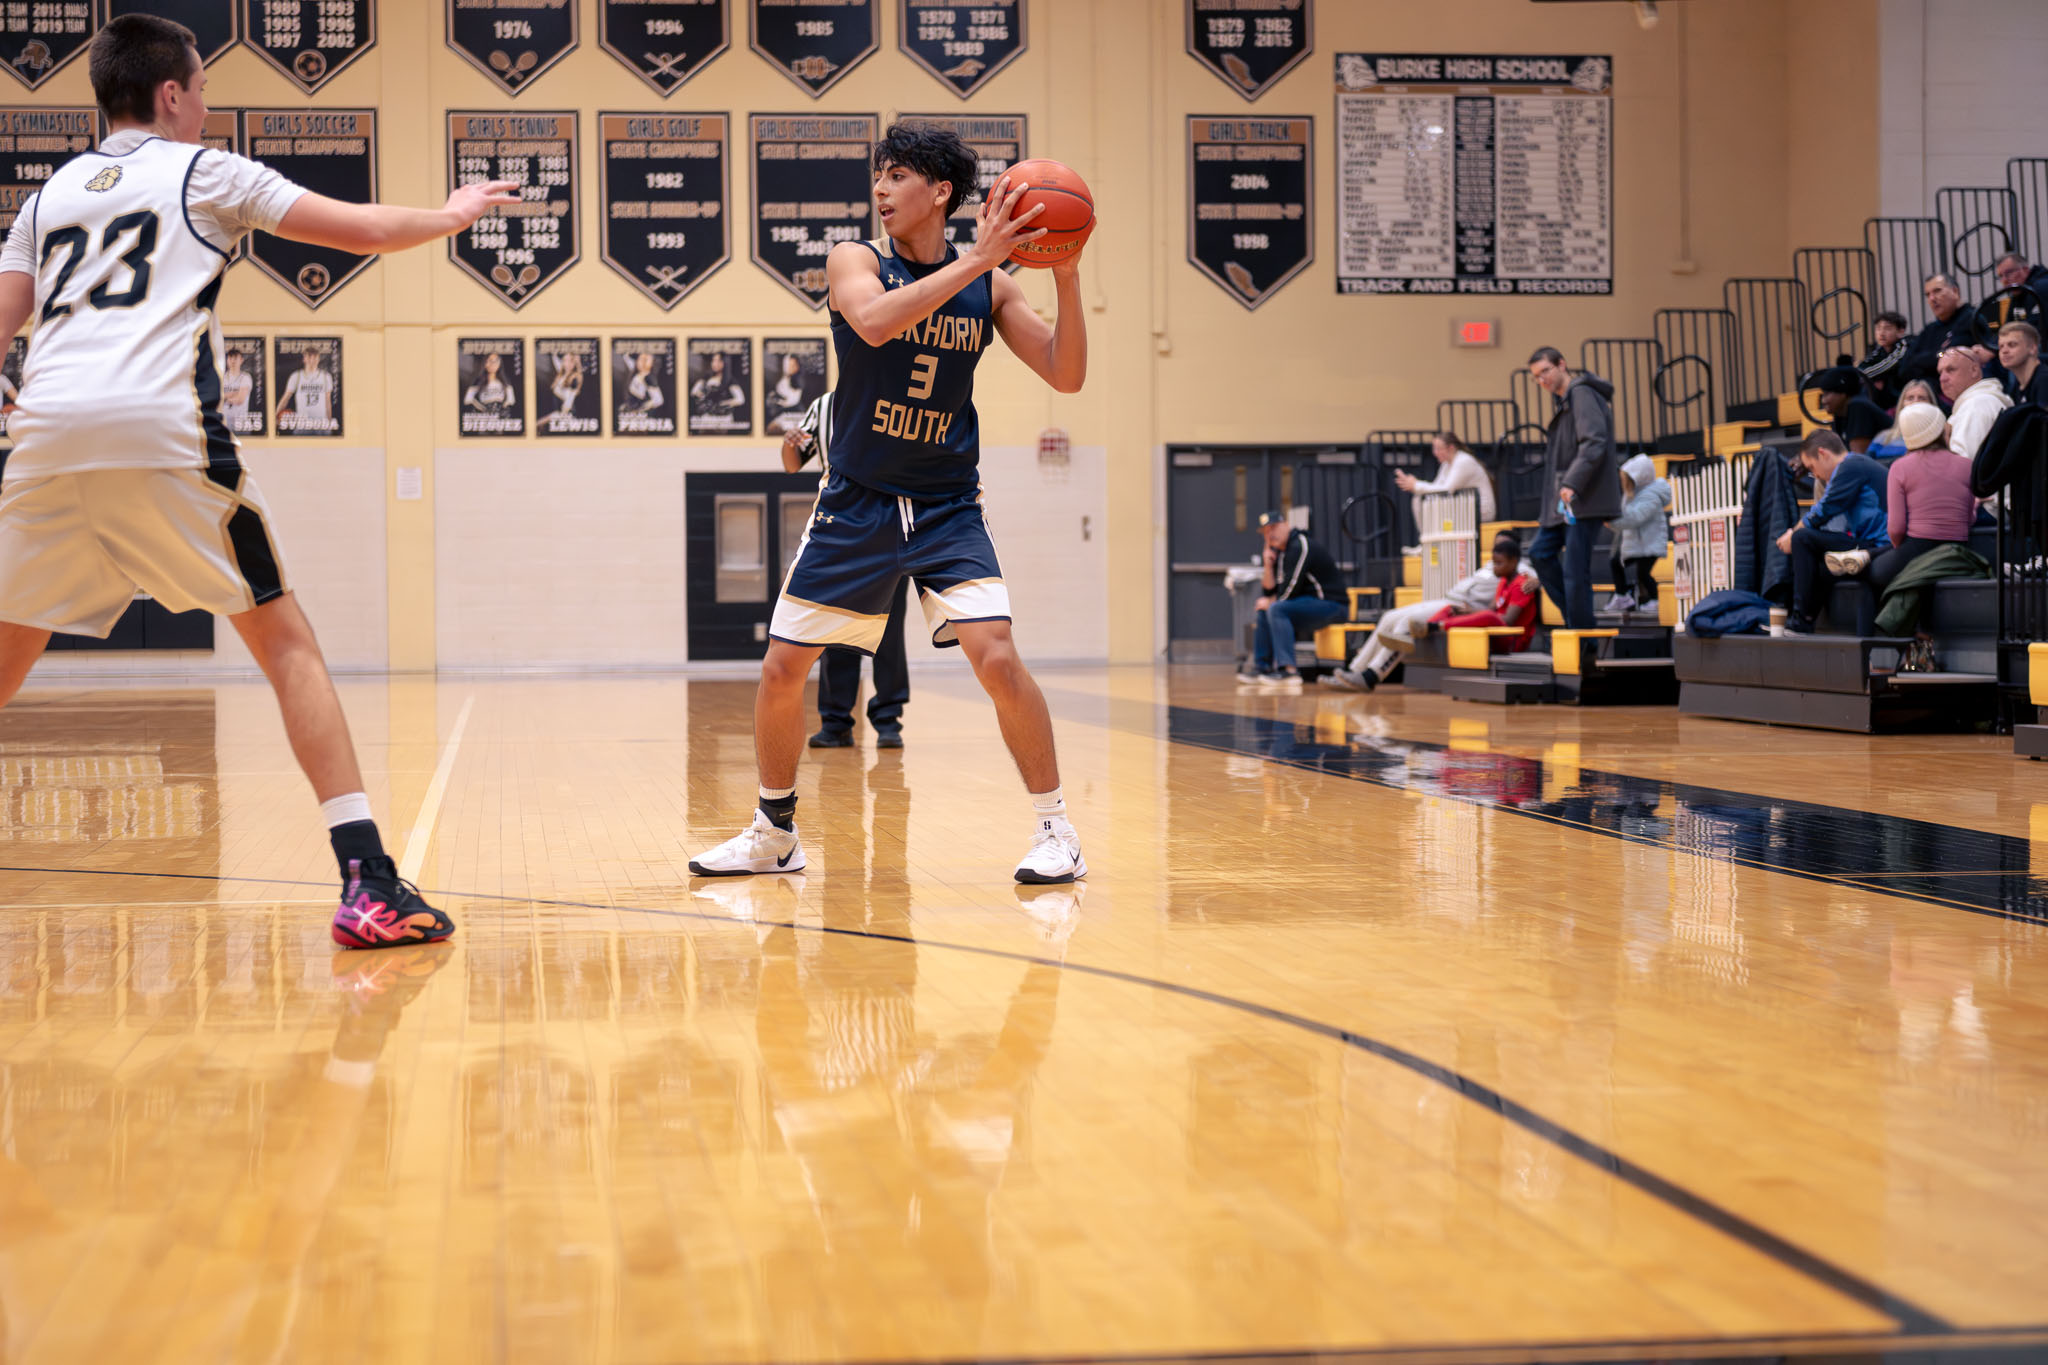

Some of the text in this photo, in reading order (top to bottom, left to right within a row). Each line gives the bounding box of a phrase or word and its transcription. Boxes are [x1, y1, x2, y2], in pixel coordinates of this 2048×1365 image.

[494, 21, 532, 39] 1974
[645, 20, 684, 35] 1994
[263, 32, 355, 48] 1997 2002
[1376, 59, 1570, 81] BURKE HIGH SCHOOL
[12, 112, 91, 133] GYMNASTICS
[263, 115, 357, 136] GIRLS SOCCER
[466, 118, 558, 137] GIRLS TENNIS
[627, 118, 702, 138] GIRLS GOLF
[38, 208, 162, 328] 23
[1340, 279, 1610, 294] TRACK AND FIELD RECORDS
[895, 313, 983, 353] KHORN
[907, 353, 939, 400] 3
[548, 418, 599, 432] LEWIS
[872, 399, 953, 444] SOUTH
